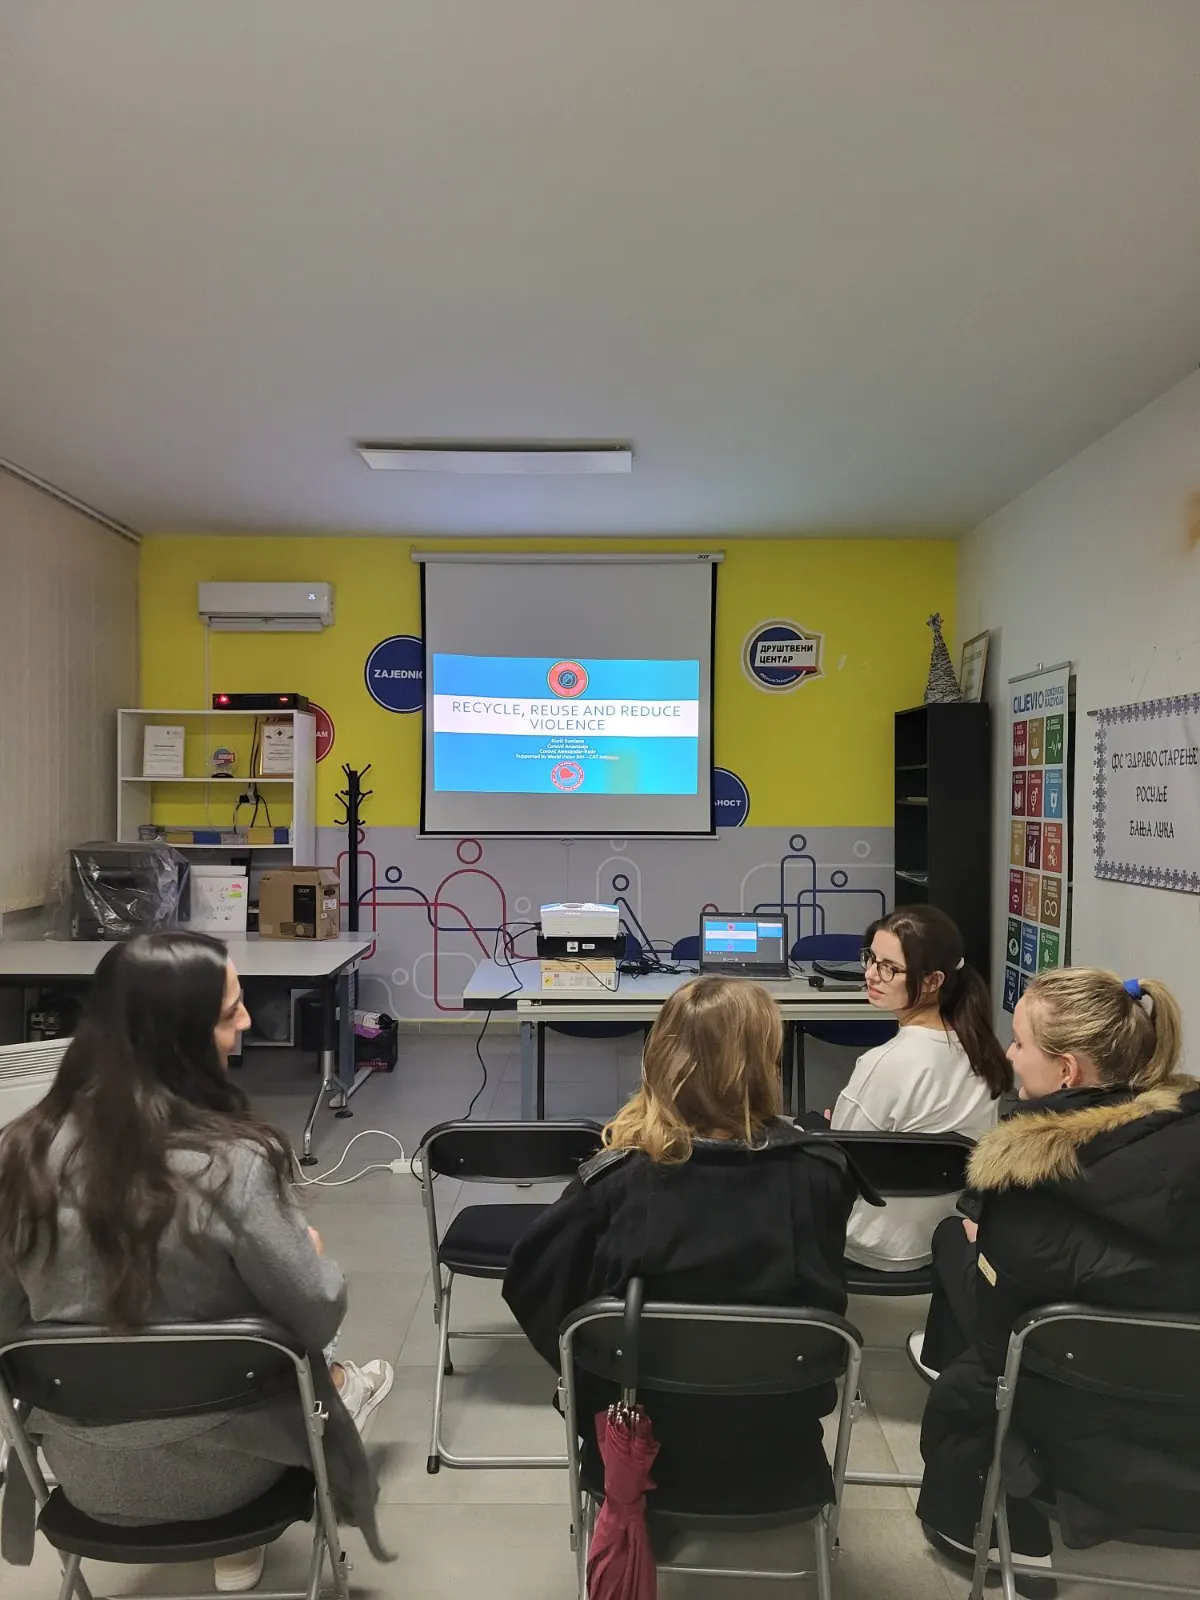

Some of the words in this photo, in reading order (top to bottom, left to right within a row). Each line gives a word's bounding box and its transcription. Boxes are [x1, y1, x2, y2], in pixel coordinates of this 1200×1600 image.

[760, 645, 813, 653] ДРУШТВЕНИ
[760, 656, 793, 664] ЦЕНТАР
[452, 701, 525, 718] RECYCLE,
[530, 704, 579, 717] REUSE
[582, 705, 616, 717] AND
[621, 705, 681, 718] REDUCE
[530, 719, 606, 731] VIOLENCE
[1136, 786, 1167, 802] РОСУЉЕ
[1129, 820, 1152, 837] БАЊА
[1153, 821, 1175, 838] ЛУКА
